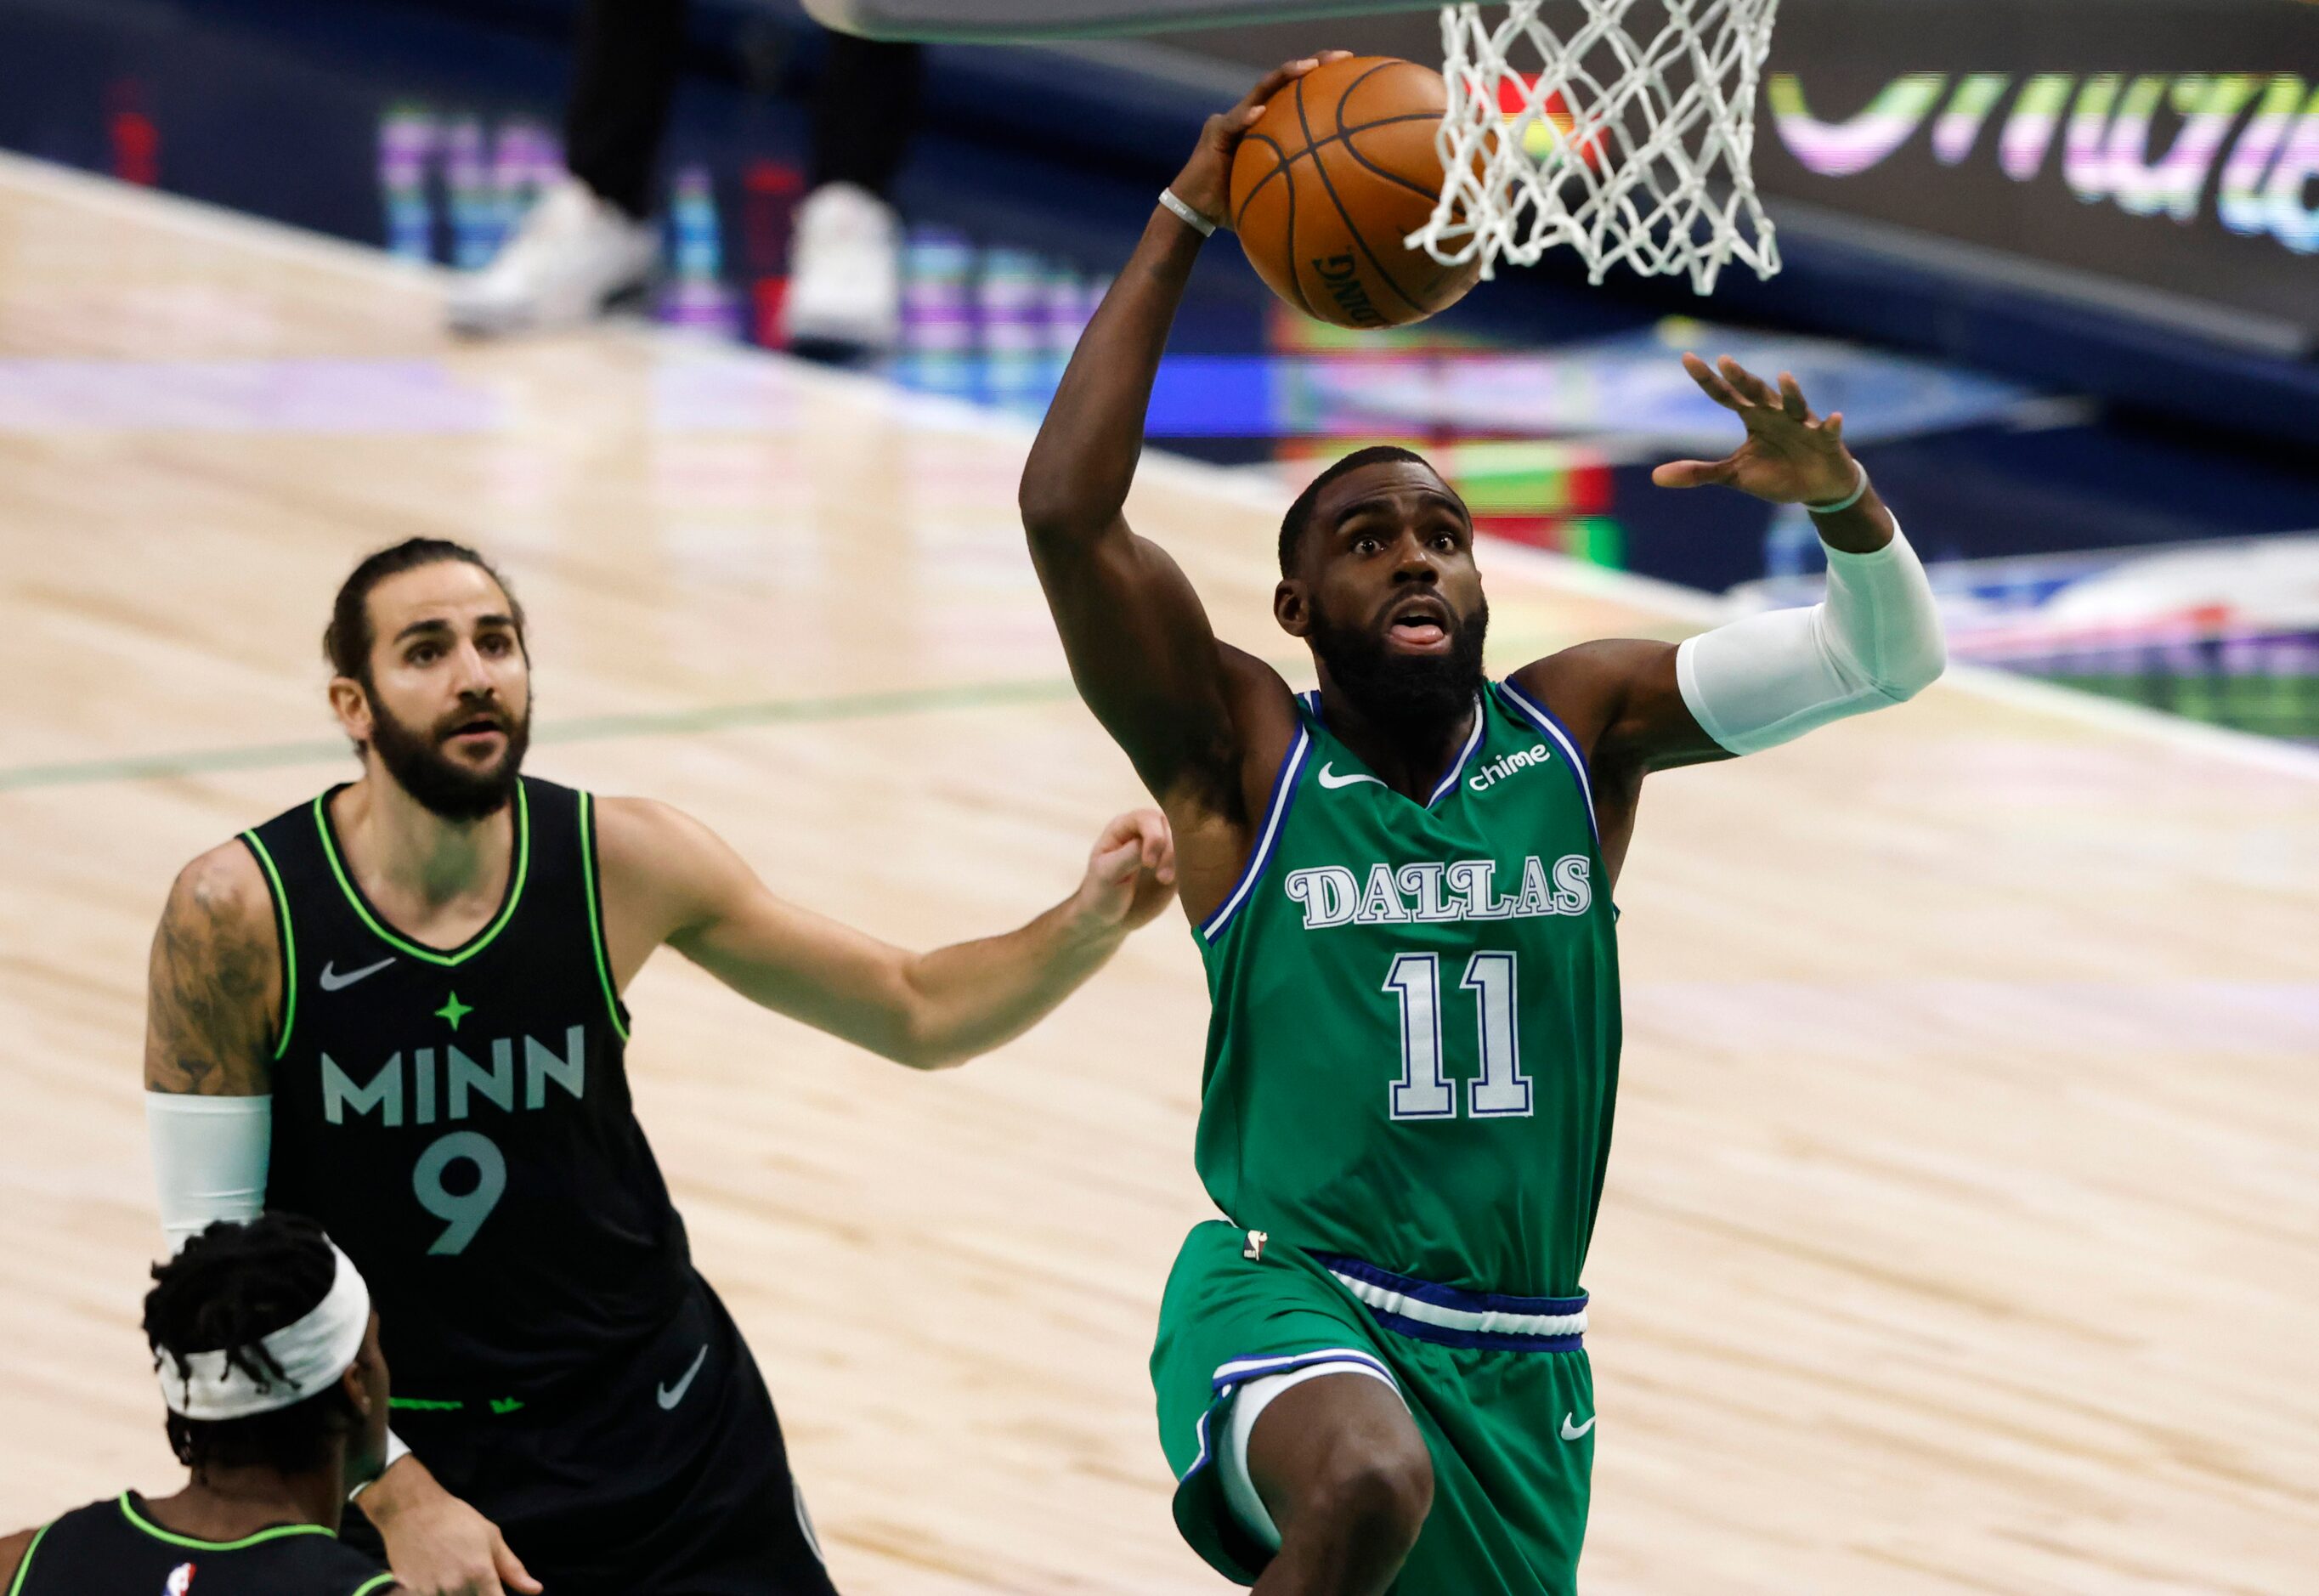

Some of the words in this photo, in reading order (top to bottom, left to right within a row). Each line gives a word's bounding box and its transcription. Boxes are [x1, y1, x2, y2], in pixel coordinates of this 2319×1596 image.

[1469, 744, 1551, 791] chime
[1285, 854, 1592, 930] DALLAS
[321, 1024, 585, 1127] MINN
[1382, 950, 1533, 1120] 11
[413, 1130, 507, 1255] 9
